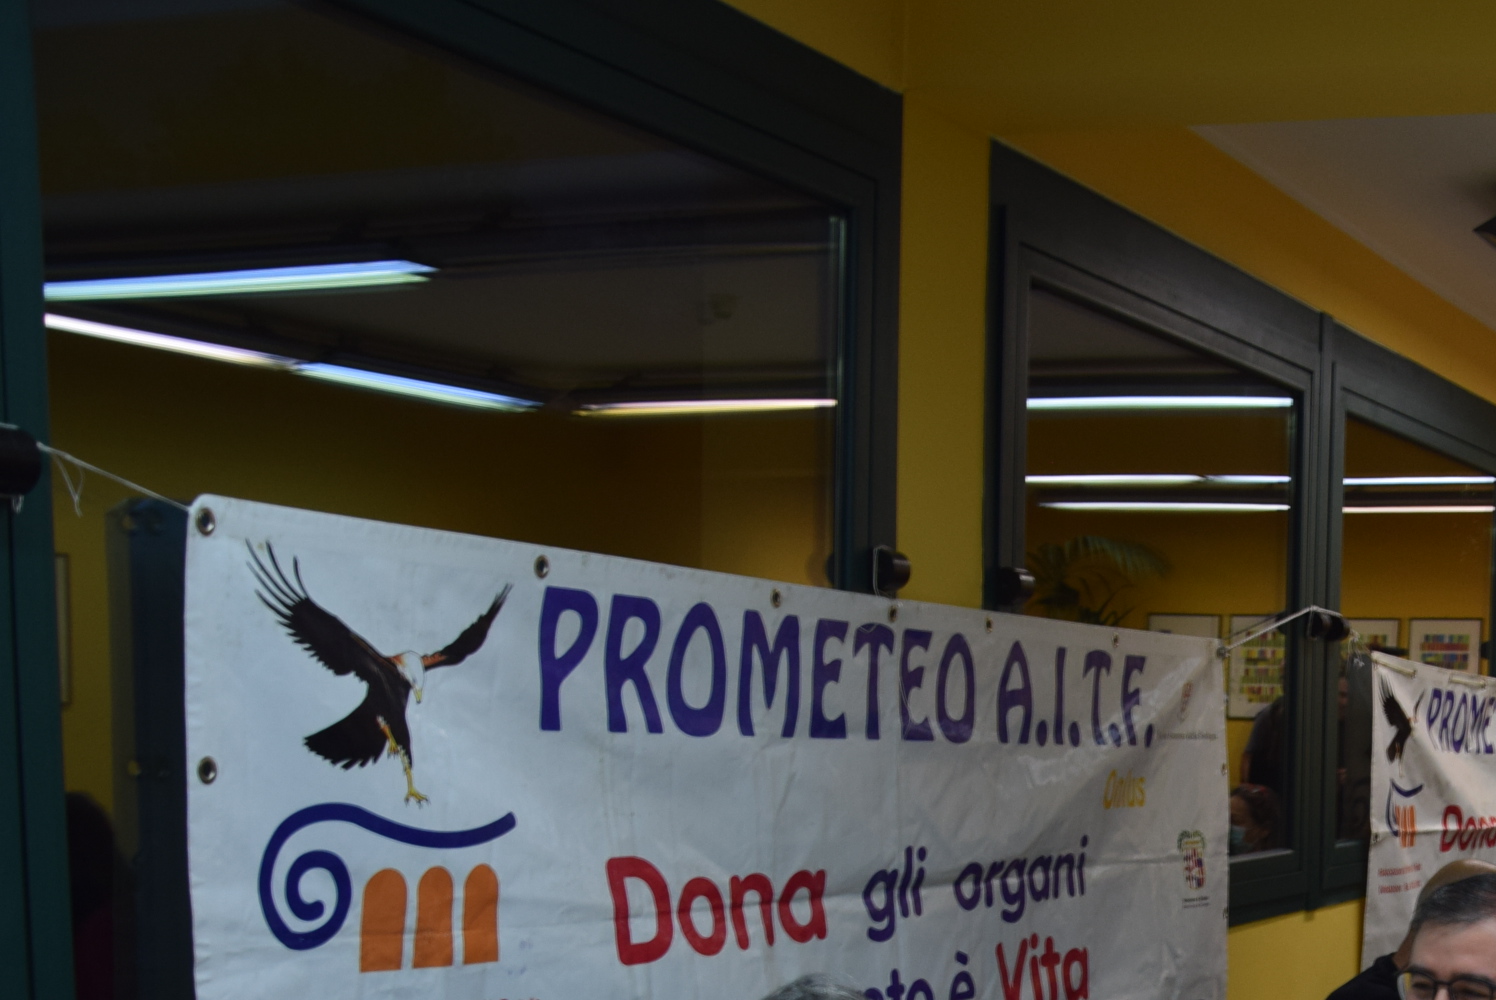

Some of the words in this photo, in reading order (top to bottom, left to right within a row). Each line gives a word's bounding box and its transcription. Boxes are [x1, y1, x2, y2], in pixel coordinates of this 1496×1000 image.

[538, 586, 976, 744] PROMETEO
[997, 639, 1155, 749] A.I.T.F.
[605, 855, 828, 966] Dona
[862, 845, 926, 943] gli
[953, 835, 1089, 922] organi
